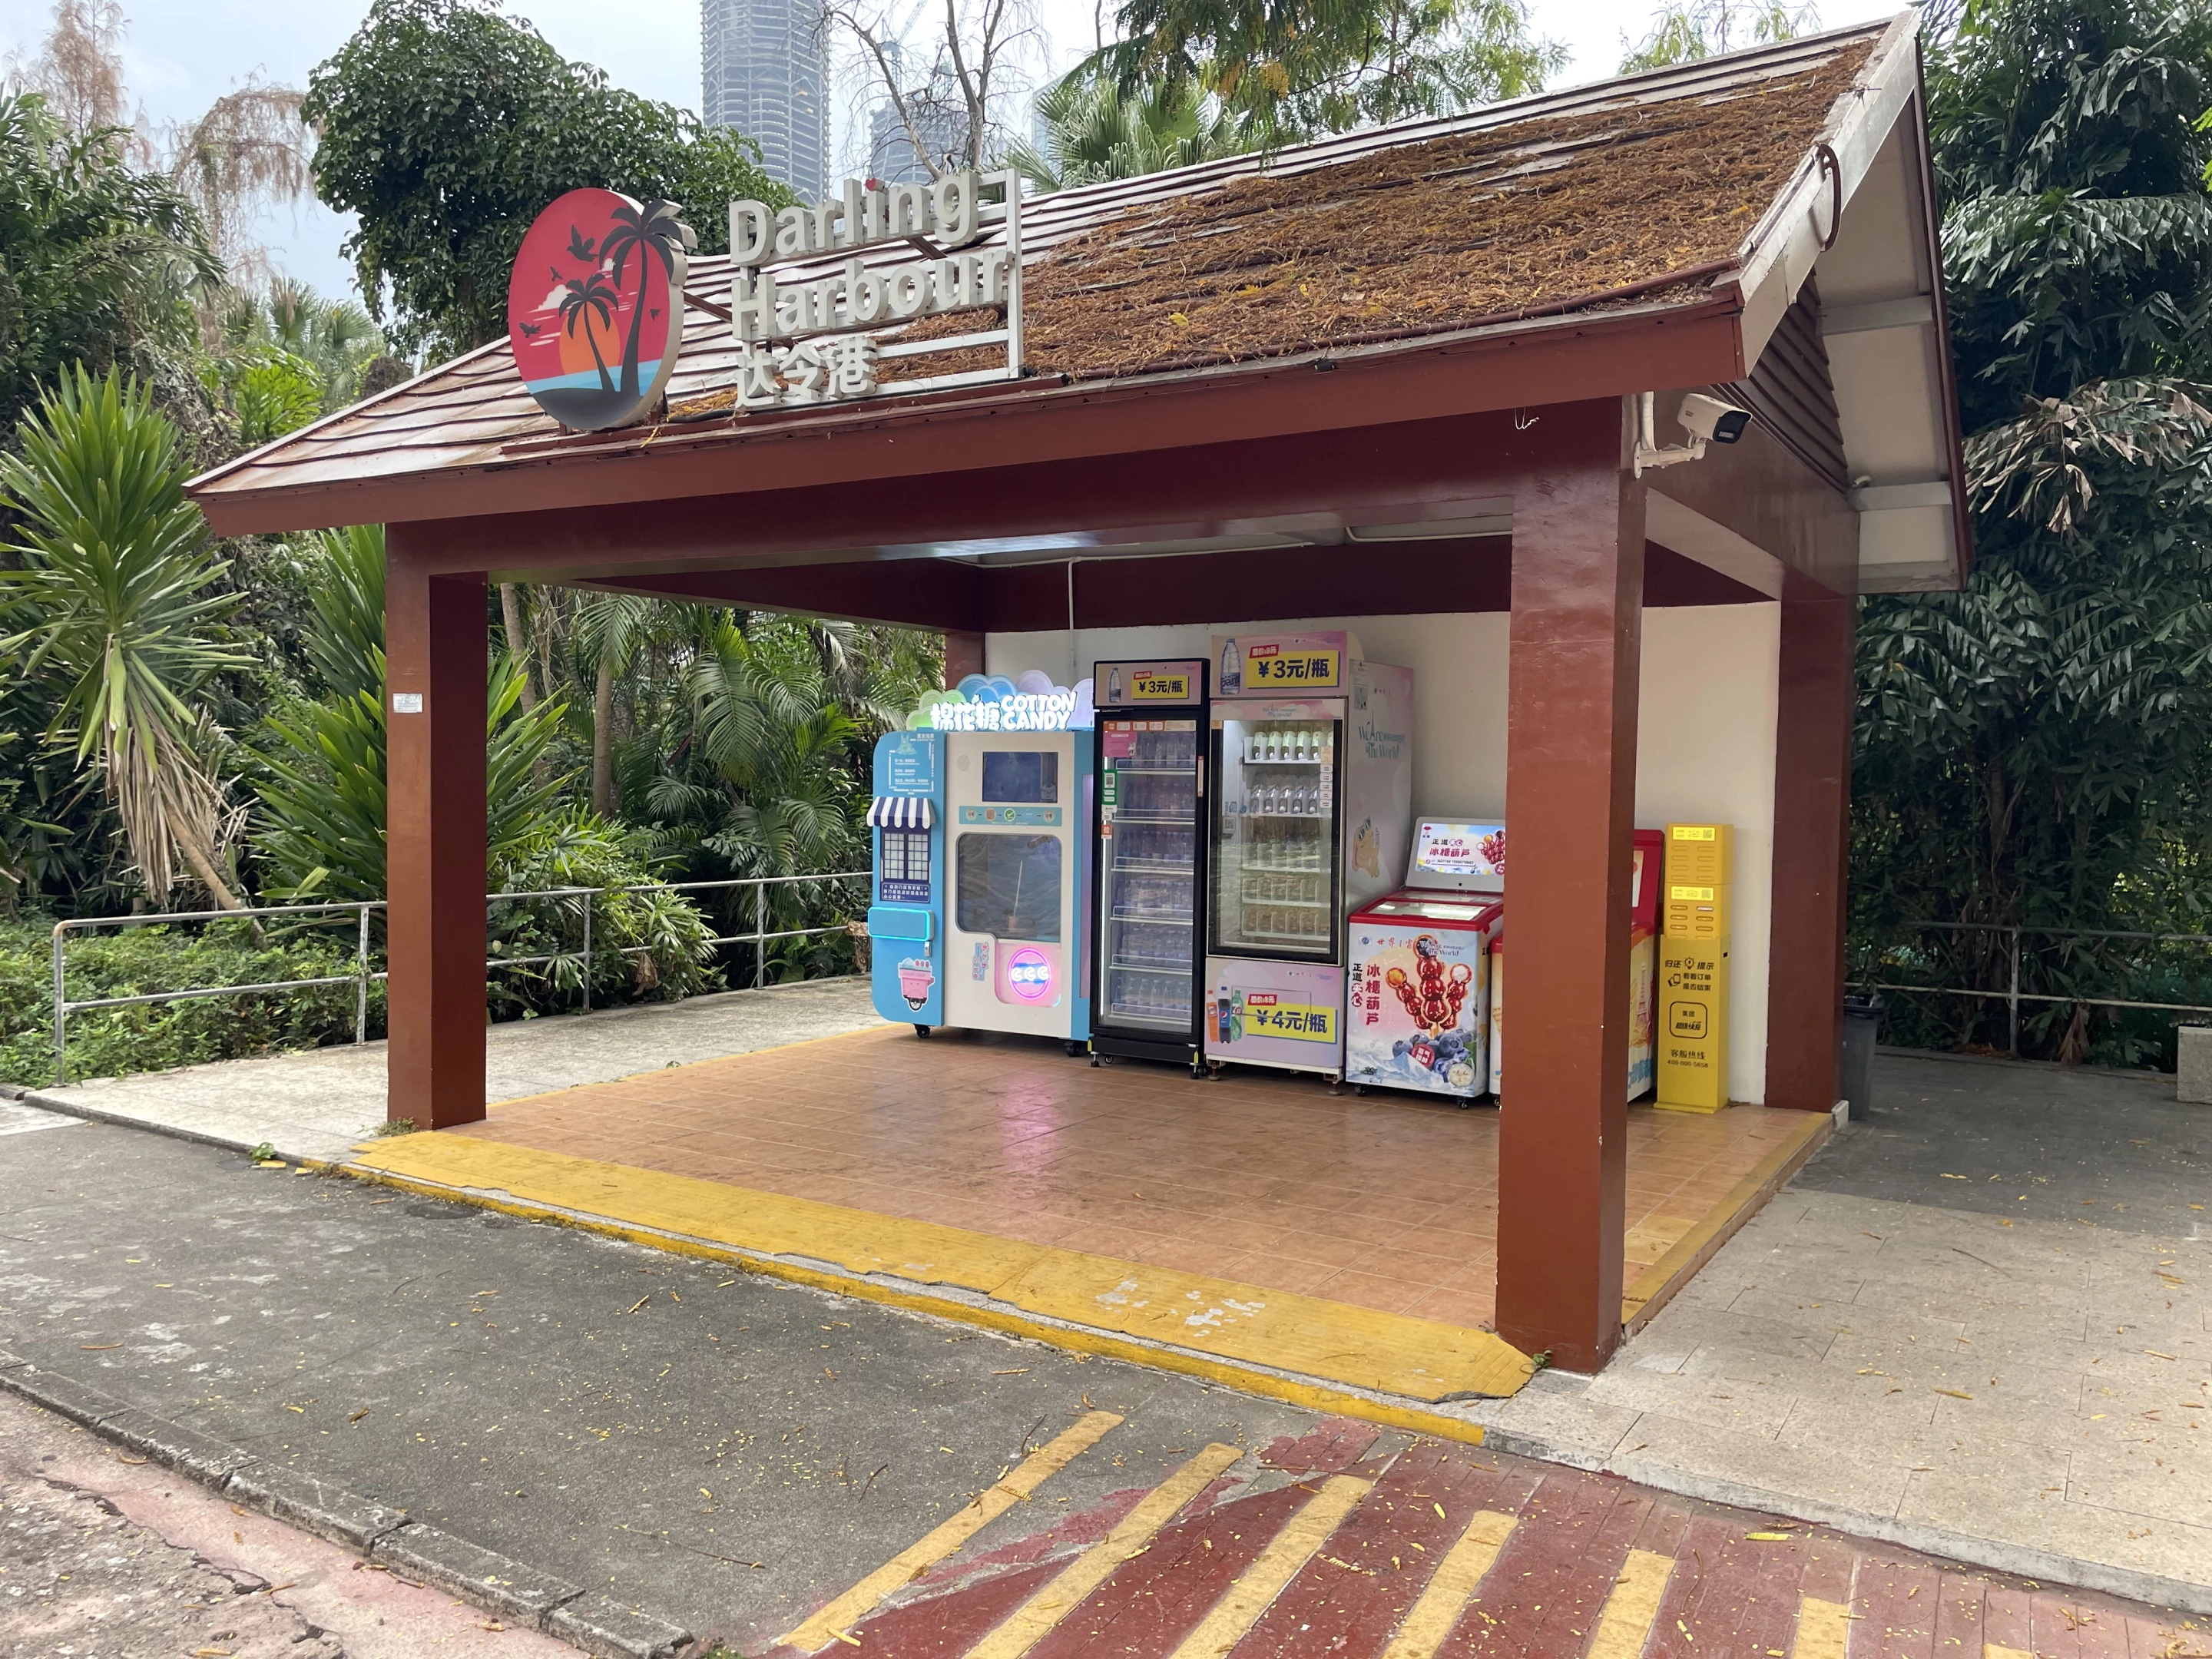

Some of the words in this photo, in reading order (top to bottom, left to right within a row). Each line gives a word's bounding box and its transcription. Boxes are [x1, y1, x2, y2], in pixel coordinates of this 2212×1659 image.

[729, 172, 980, 267] Darling
[732, 250, 1015, 340] Harbour
[733, 336, 878, 409] 达令港
[1001, 691, 1077, 713] COTTON
[931, 700, 1000, 730] 棉花糖
[1002, 710, 1071, 730] CANDY
[1379, 744, 1400, 760] World
[1429, 847, 1470, 858] 冰糖葫芦
[1664, 959, 1682, 969] 归还
[1697, 962, 1715, 970] 提示
[1683, 972, 1711, 981] 看看订单
[1365, 964, 1381, 1025] 冰糖葫芦
[1683, 983, 1711, 992] 是否结束
[1671, 1049, 1705, 1061] 客服热线
